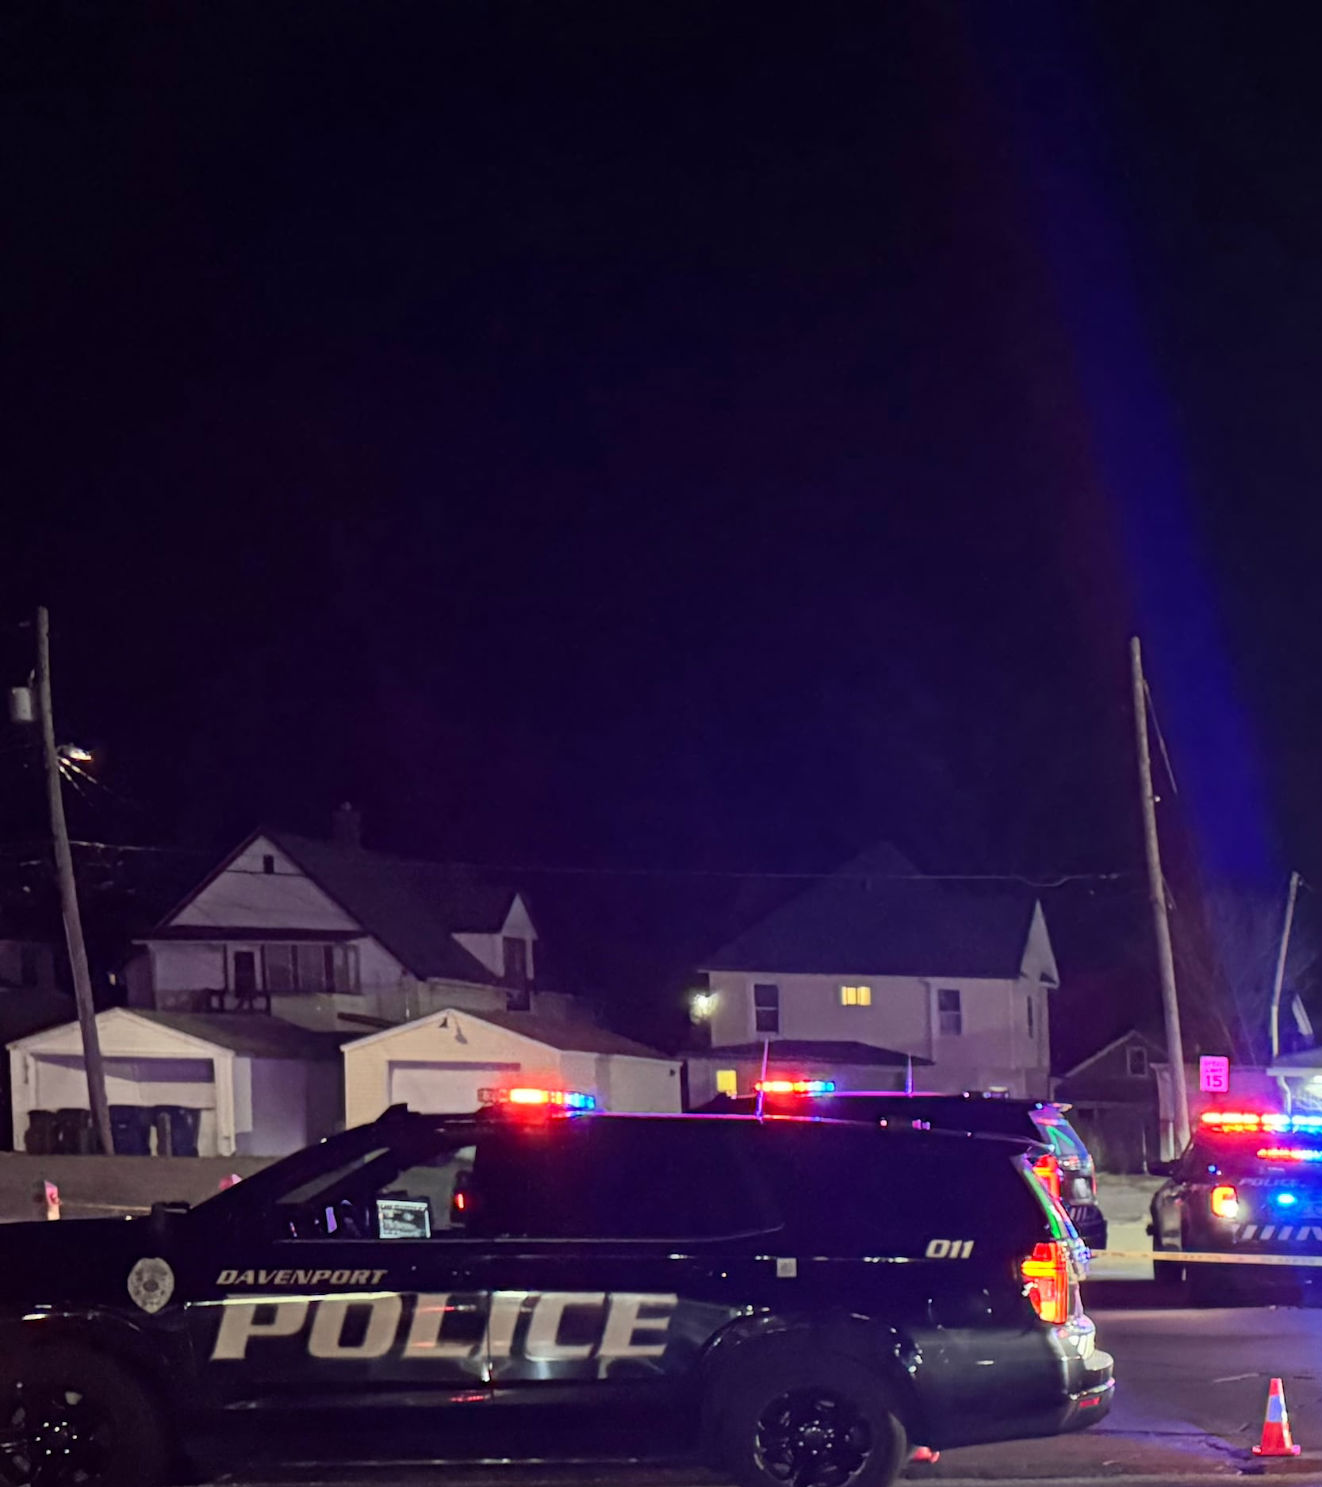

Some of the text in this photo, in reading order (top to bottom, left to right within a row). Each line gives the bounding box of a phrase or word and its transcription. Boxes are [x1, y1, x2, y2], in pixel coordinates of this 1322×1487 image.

[1206, 1075, 1222, 1087] 15
[925, 1239, 974, 1259] 011
[216, 1269, 388, 1285] DAVENPORT
[210, 1291, 678, 1361] POLICE
